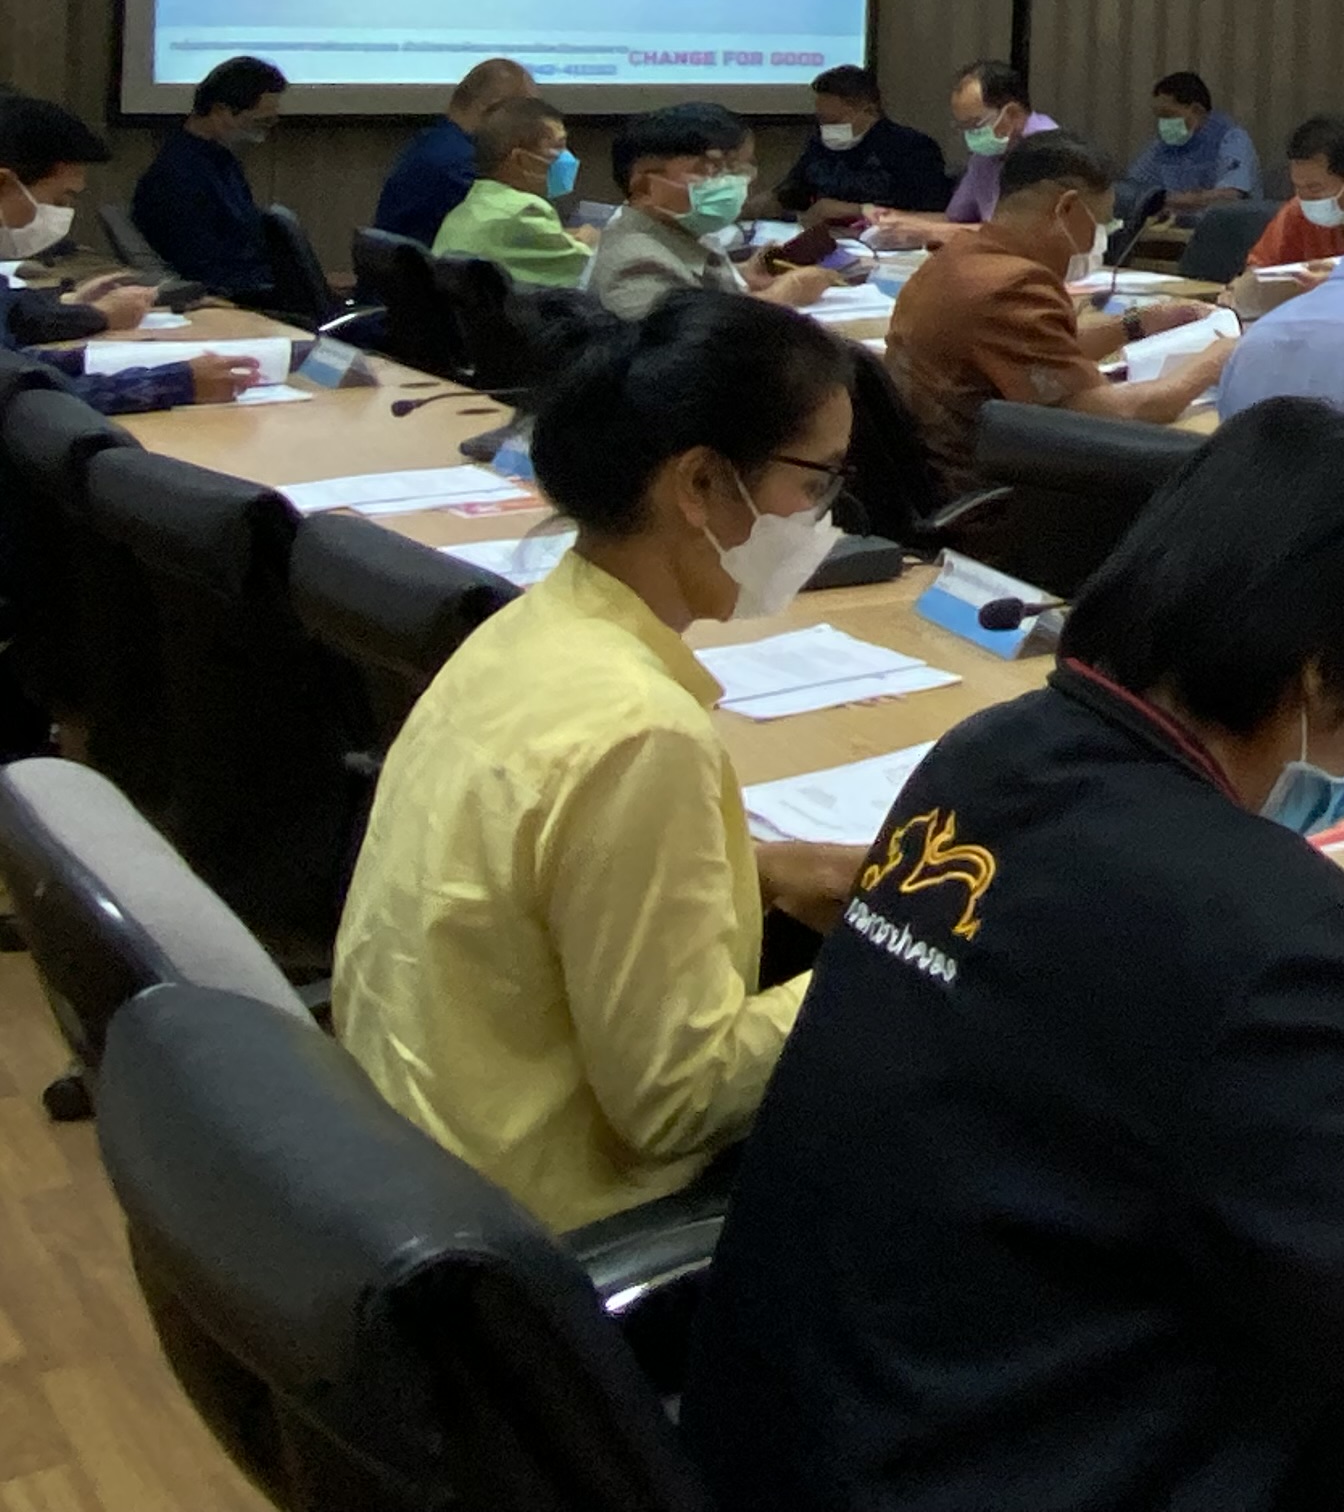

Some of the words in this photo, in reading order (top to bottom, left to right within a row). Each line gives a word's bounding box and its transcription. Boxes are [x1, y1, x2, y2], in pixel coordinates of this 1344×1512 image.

[628, 51, 717, 66] CHANGE
[723, 51, 763, 66] FOR
[770, 52, 825, 67] GOOD
